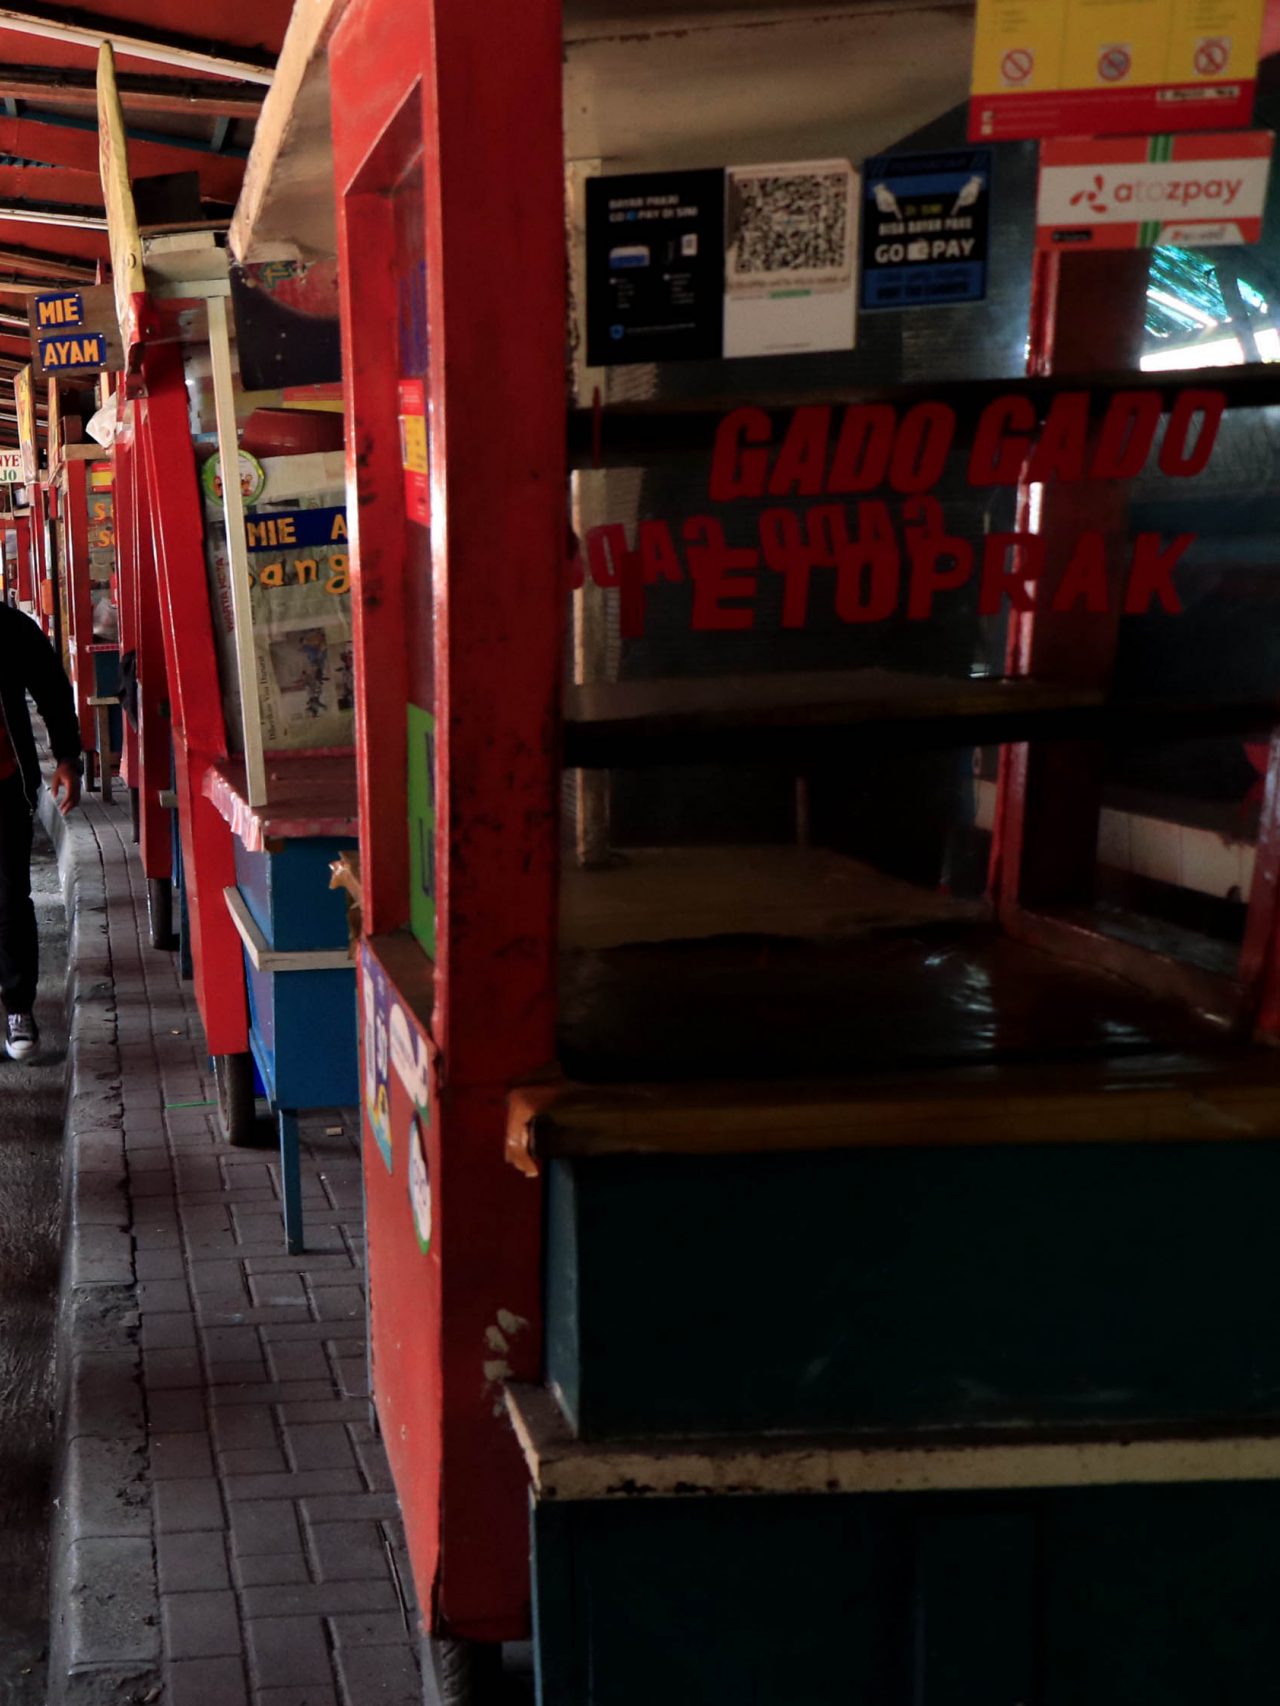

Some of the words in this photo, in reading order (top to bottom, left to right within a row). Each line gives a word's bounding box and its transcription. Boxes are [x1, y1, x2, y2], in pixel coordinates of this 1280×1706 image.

[1114, 178, 1242, 205] atozpay
[874, 242, 905, 264] GO
[931, 237, 977, 259] PAY
[38, 297, 79, 326] MIE
[44, 339, 100, 367] AYAM
[708, 404, 956, 502] GADO
[967, 390, 1228, 487] GADO
[246, 516, 297, 547] MIE
[248, 553, 351, 595] ang
